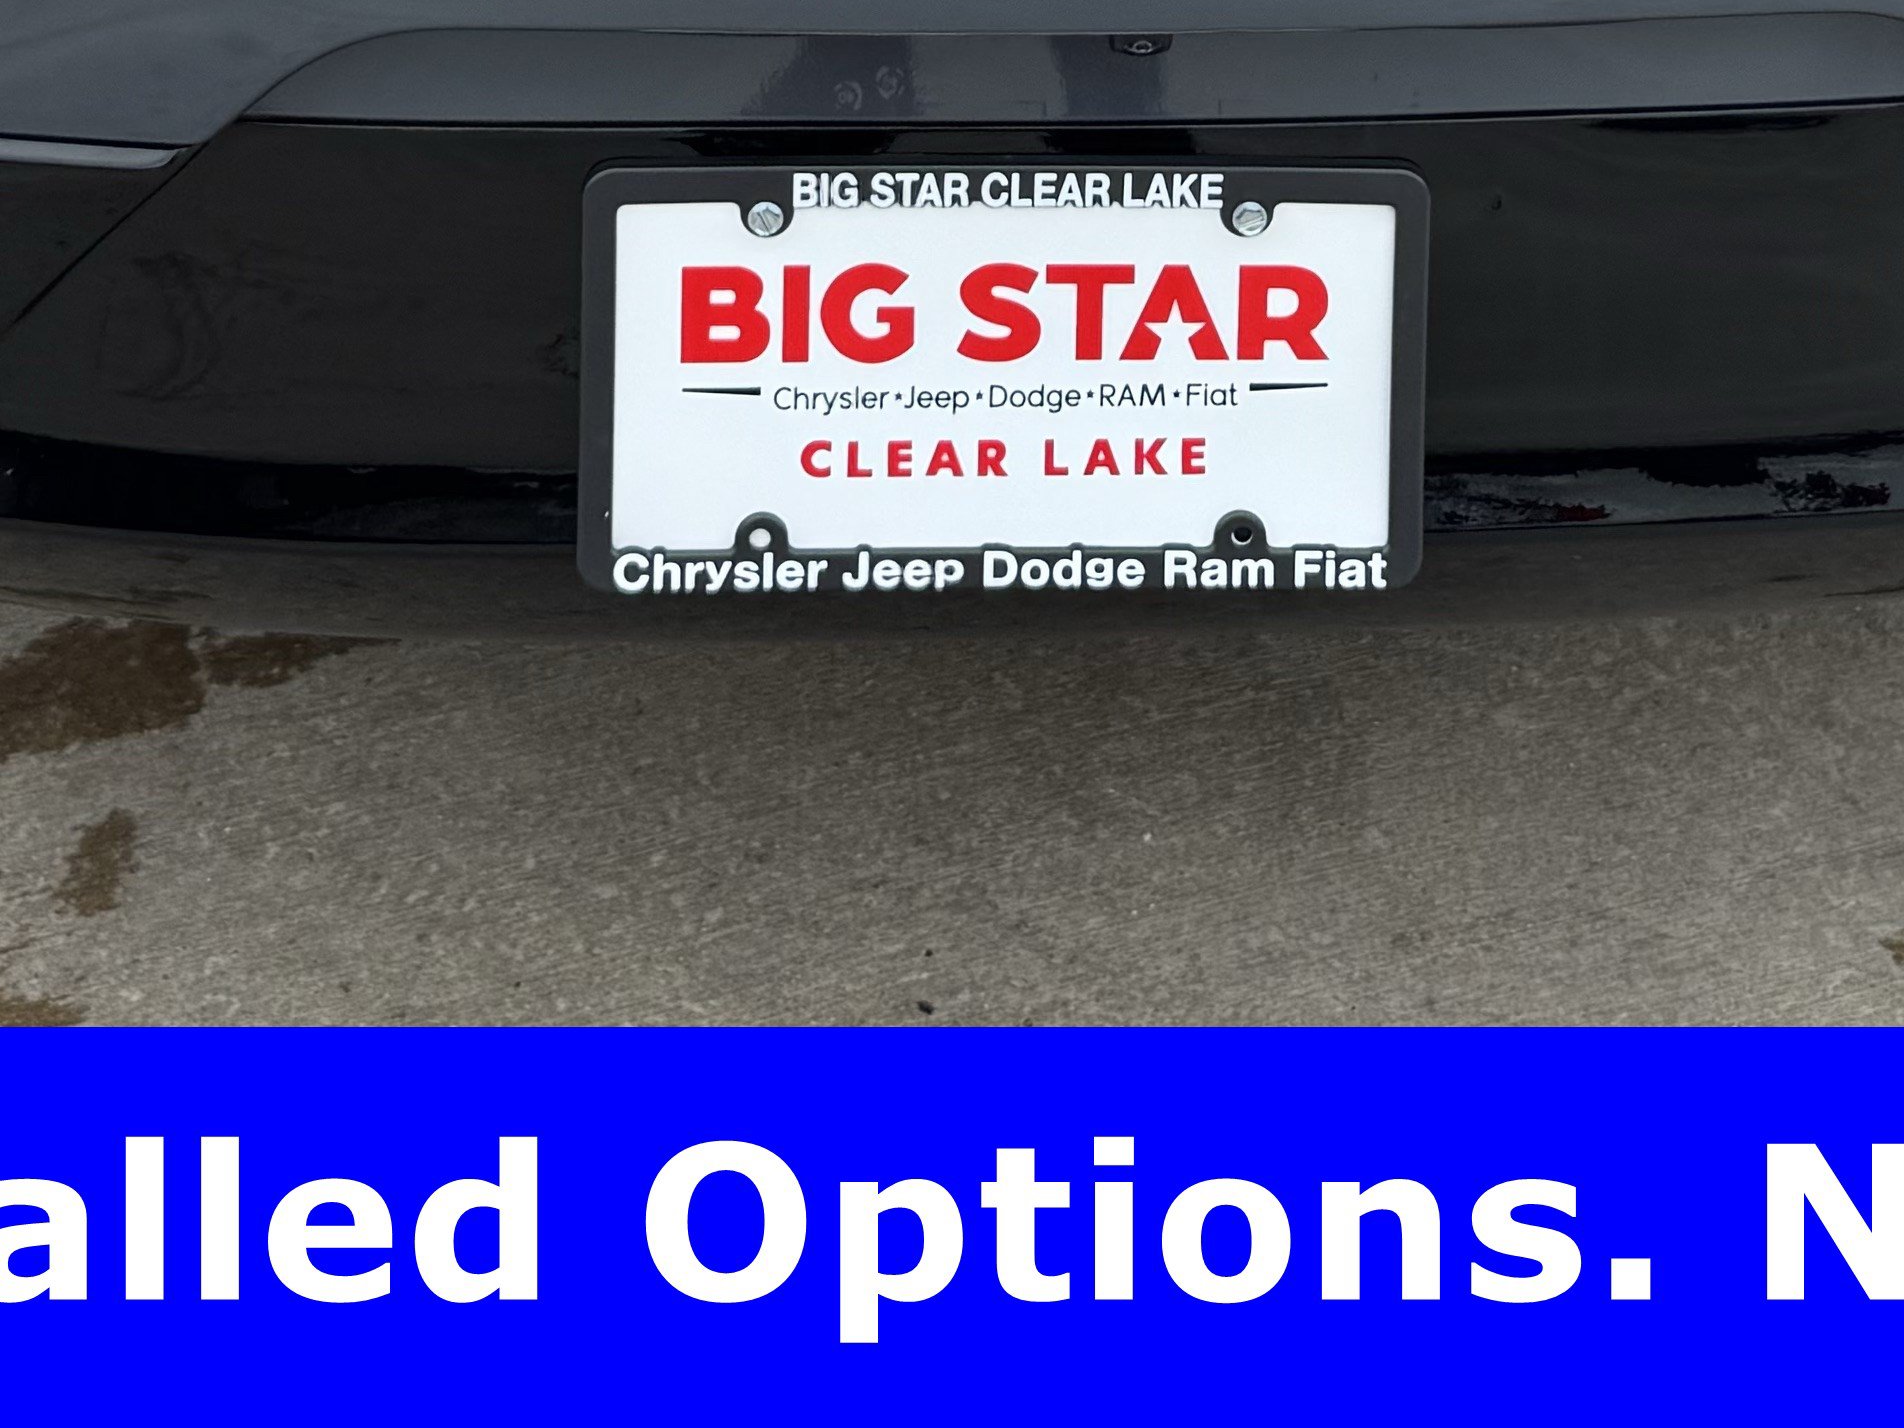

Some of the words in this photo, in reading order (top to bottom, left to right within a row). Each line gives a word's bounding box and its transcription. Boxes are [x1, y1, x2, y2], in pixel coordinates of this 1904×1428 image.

[793, 172, 859, 208] BIG
[870, 172, 970, 208] STAR
[981, 172, 1111, 208] CLEAR
[1123, 172, 1225, 208] LAKE
[681, 263, 915, 364] BIG
[958, 262, 1329, 362] STAR
[773, 386, 889, 415] Chrysler
[903, 386, 970, 414] Jeep
[989, 384, 1082, 414] Dodge
[1099, 384, 1166, 407] RAM
[1186, 383, 1238, 407] Fiat
[800, 439, 1008, 478] CLEAR
[1044, 437, 1206, 476] LAKE
[612, 551, 829, 594] Chrysler
[841, 550, 965, 592] Jeep
[982, 549, 1146, 590] Dodge
[1163, 549, 1275, 590] Ram
[1293, 549, 1388, 589] Fiat
